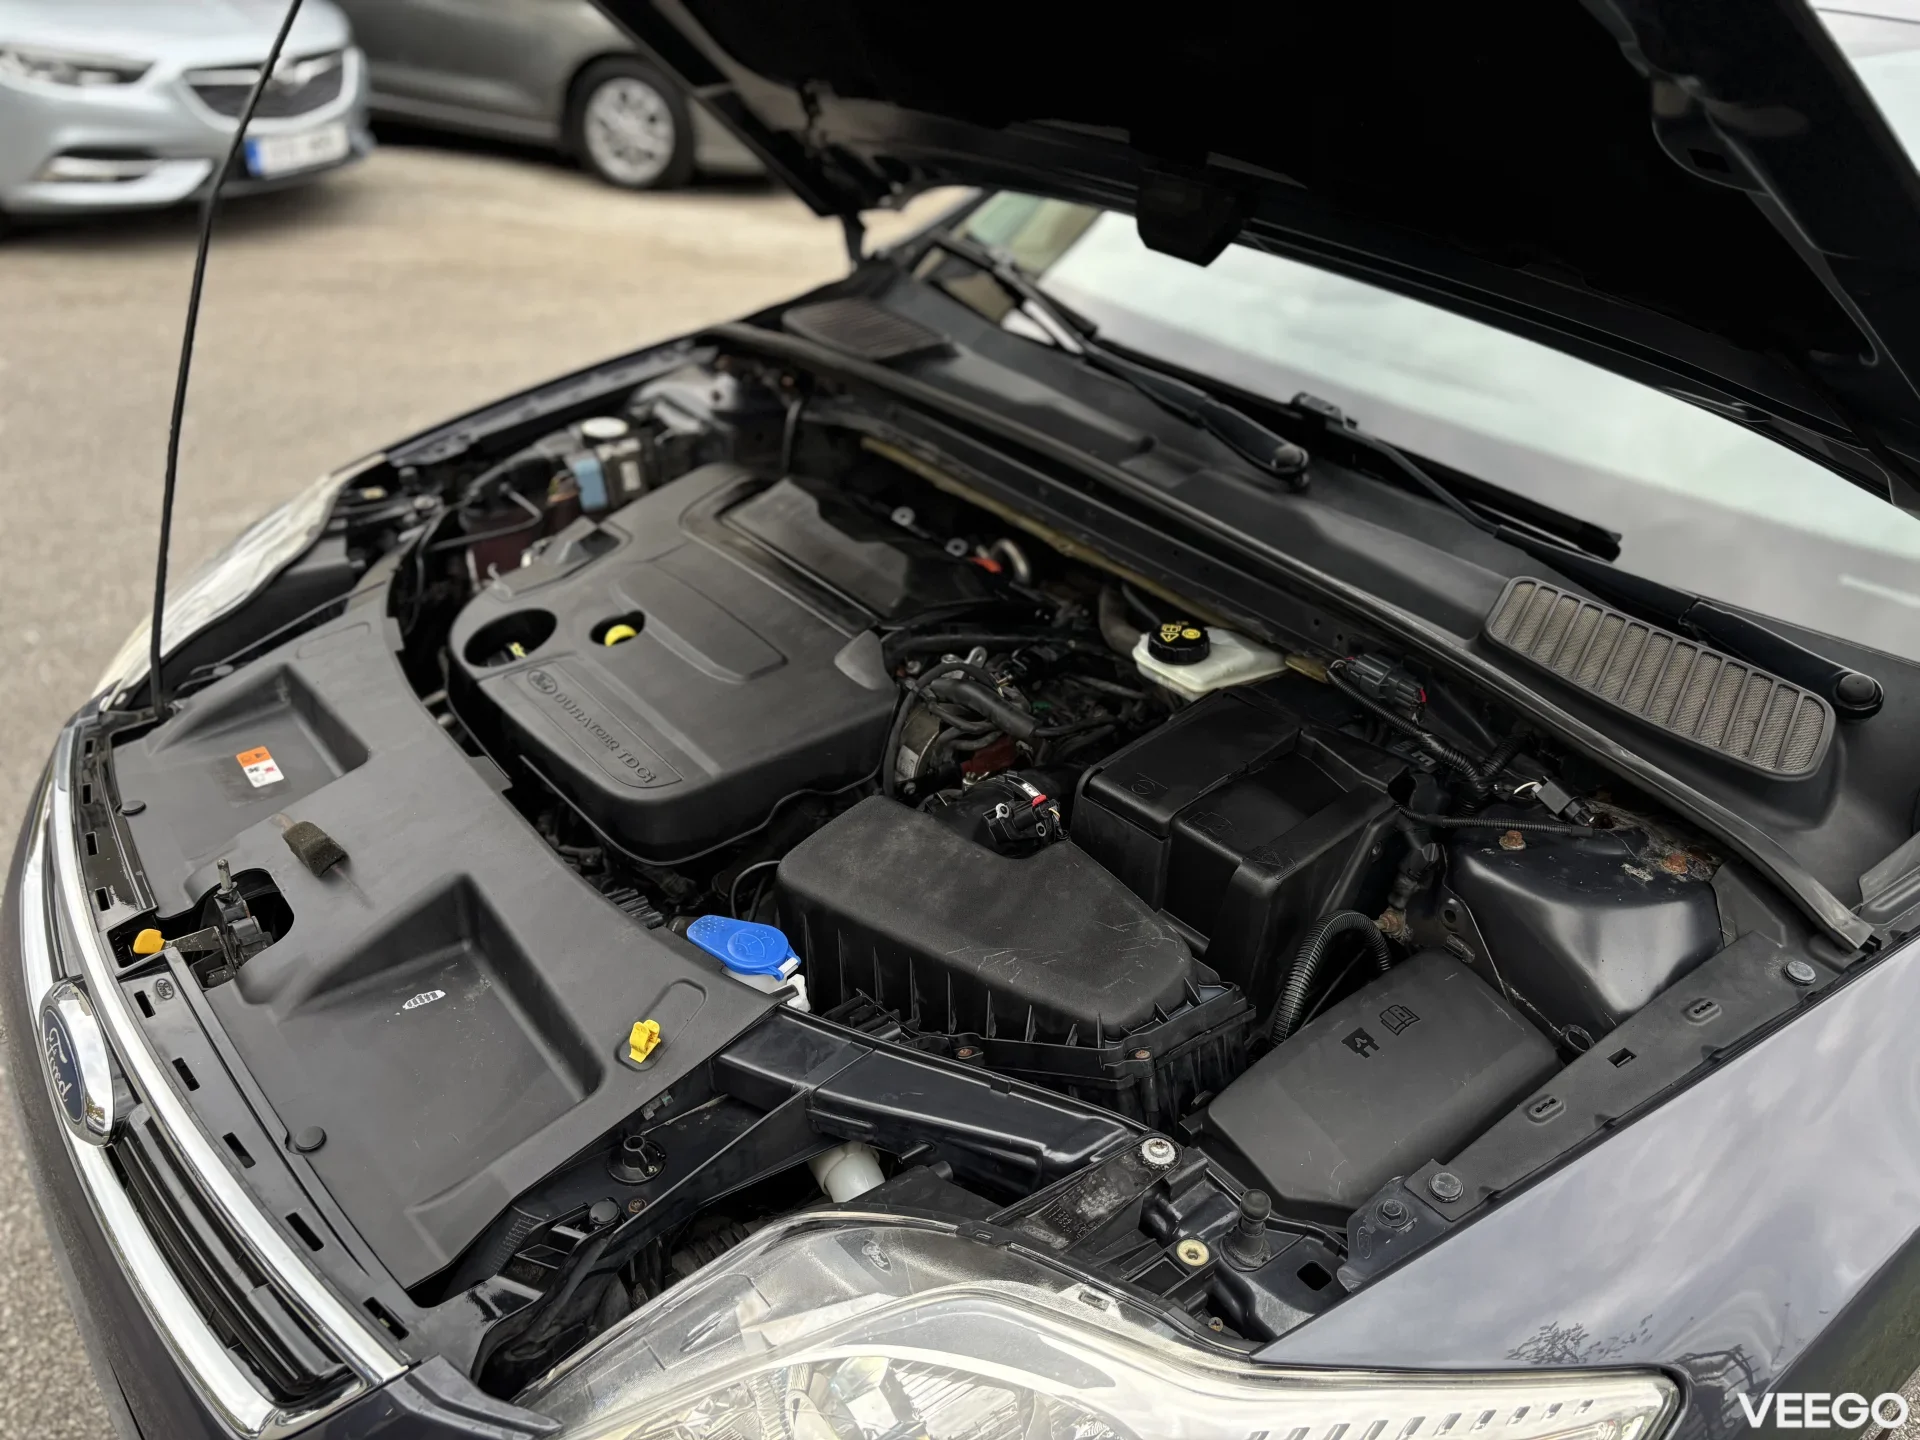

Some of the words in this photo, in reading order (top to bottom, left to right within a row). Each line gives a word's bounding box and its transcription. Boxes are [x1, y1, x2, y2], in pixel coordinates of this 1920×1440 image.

[553, 692, 621, 752] DURATORQ
[616, 747, 658, 784] TDCi
[45, 1027, 73, 1103] Ford
